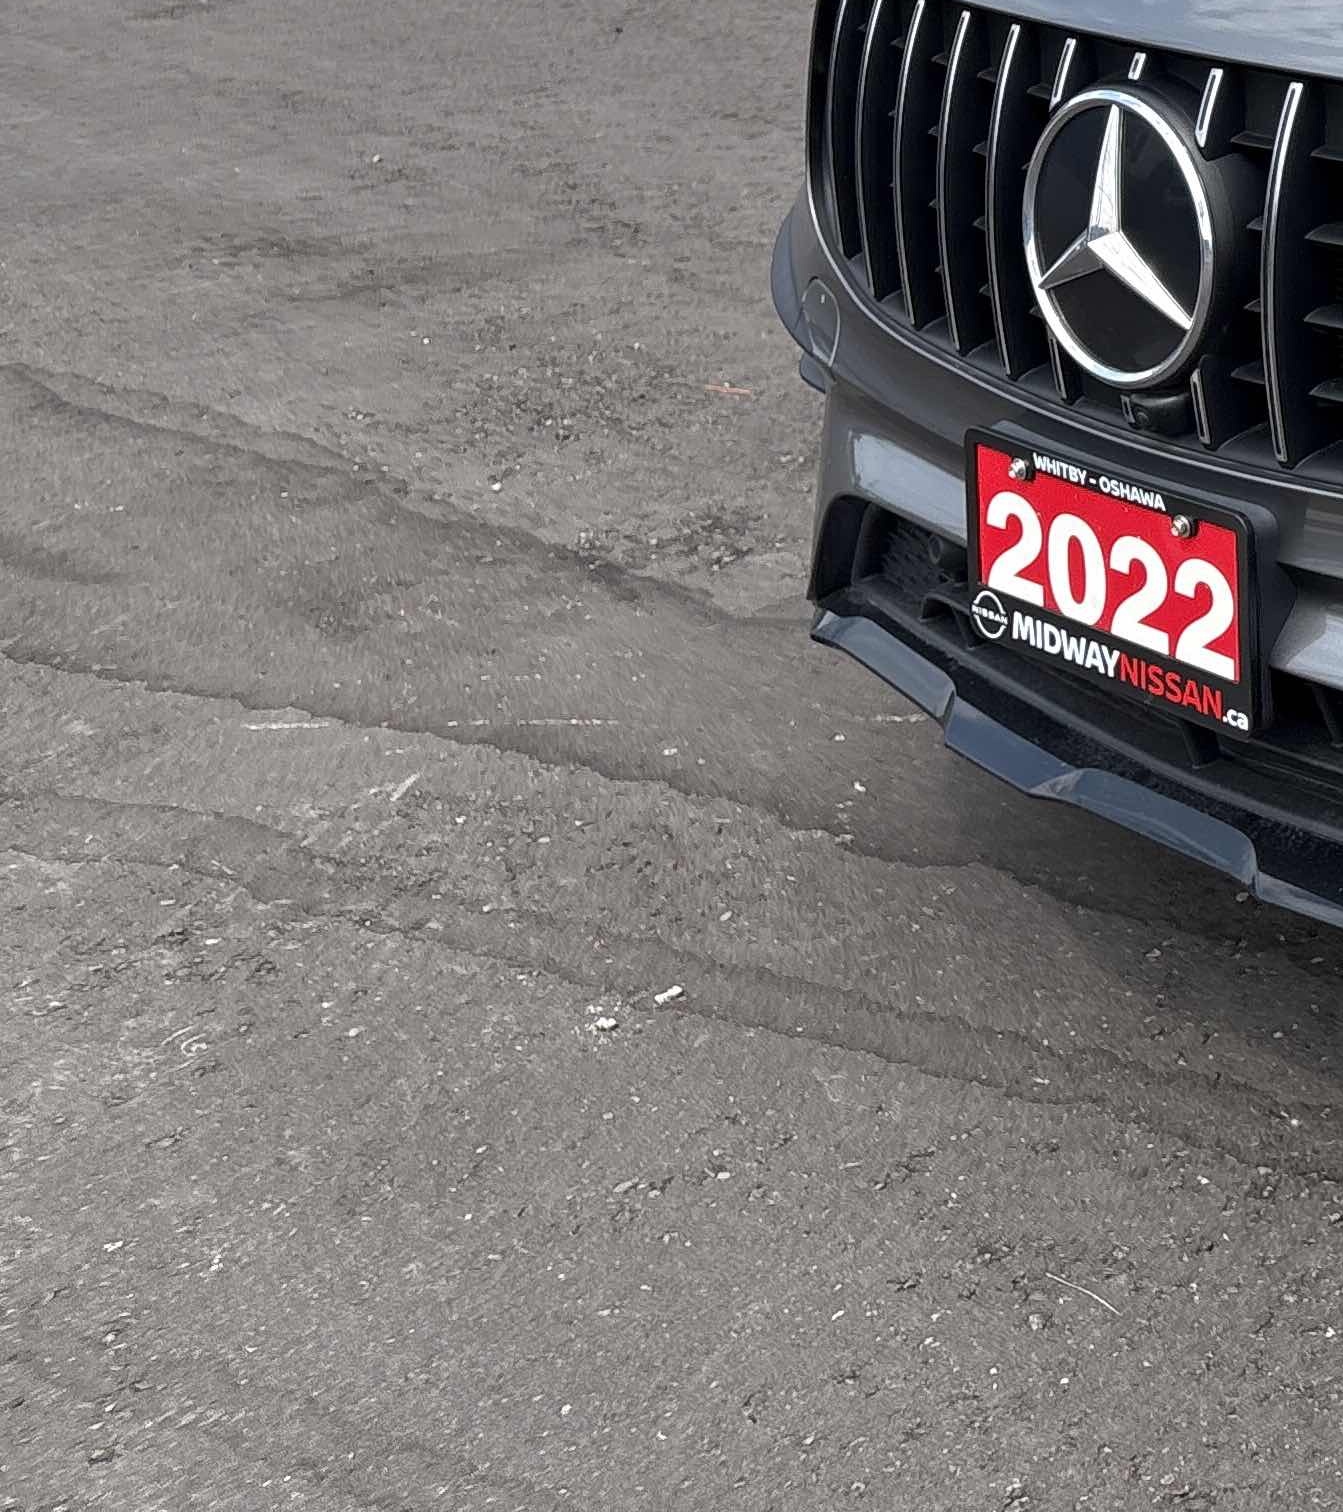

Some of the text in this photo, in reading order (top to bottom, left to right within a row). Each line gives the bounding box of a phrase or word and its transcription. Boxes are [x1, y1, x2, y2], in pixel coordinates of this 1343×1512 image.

[1032, 452, 1087, 486] WHITBY
[1099, 475, 1167, 512] OSHAWA
[971, 604, 1009, 626] NISSAN
[986, 491, 1236, 682] 2022
